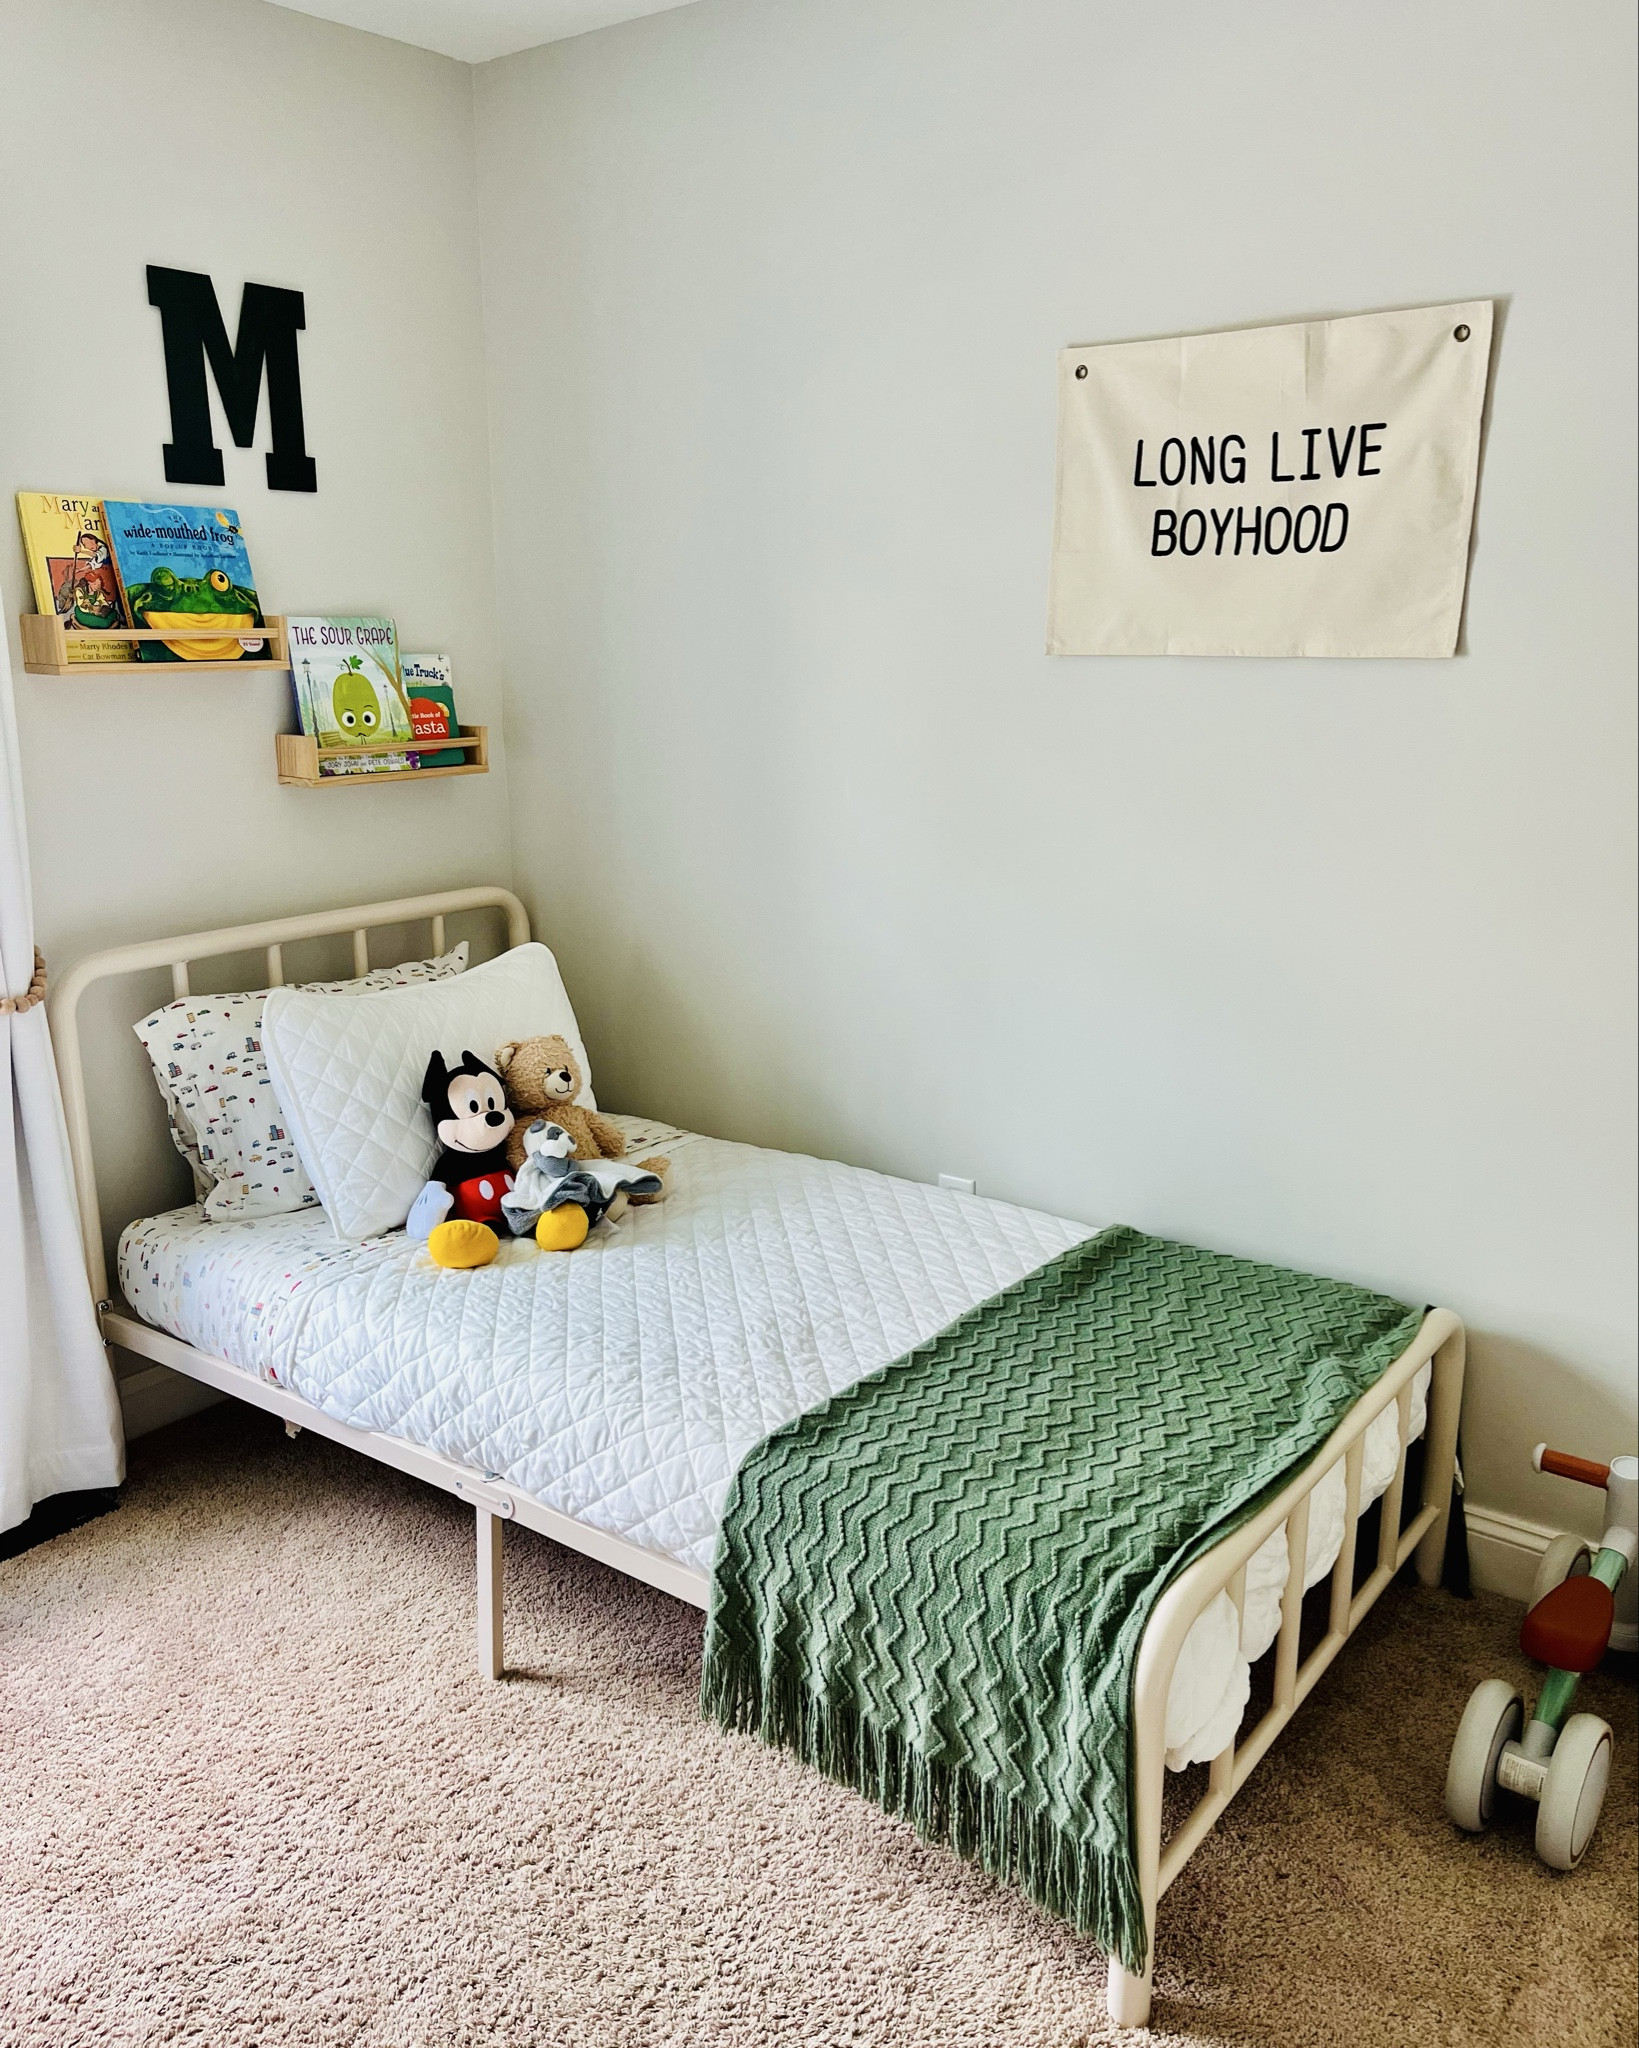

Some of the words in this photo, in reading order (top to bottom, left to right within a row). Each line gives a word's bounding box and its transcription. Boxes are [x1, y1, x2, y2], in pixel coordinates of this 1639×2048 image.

[146, 264, 317, 493] M
[1134, 434, 1247, 487] LONG
[1271, 422, 1388, 482] LIVE
[40, 495, 89, 517] Mary
[123, 522, 208, 541] wide-mouthed
[210, 526, 235, 546] frog
[1151, 502, 1350, 556] BOYHOOD
[292, 626, 317, 645] THE
[320, 626, 353, 645] SOUR
[356, 626, 394, 645] GRAPE
[80, 643, 100, 652] Marty
[414, 663, 445, 681] Truck's
[408, 721, 446, 735] asta
